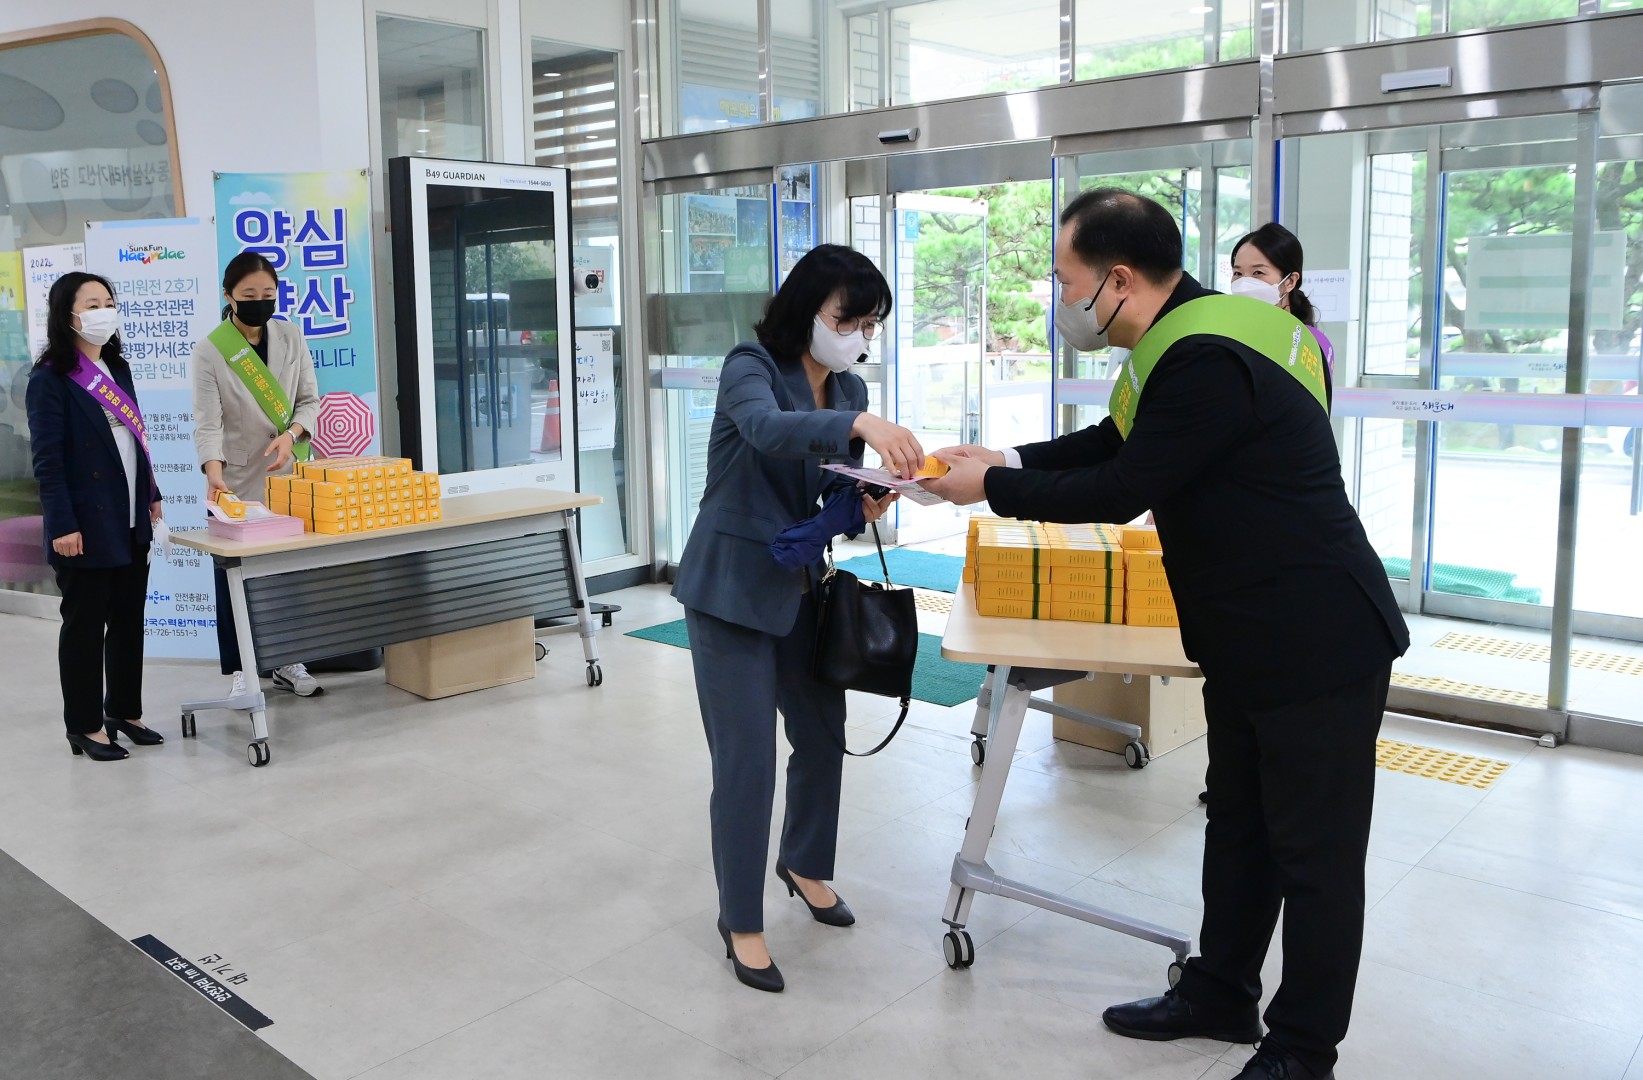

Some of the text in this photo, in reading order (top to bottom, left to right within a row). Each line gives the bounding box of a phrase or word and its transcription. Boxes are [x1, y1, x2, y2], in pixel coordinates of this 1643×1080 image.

[425, 169, 486, 181] B49 GUARDIAN
[235, 207, 346, 269] 양심
[119, 246, 186, 265] Haeundae
[129, 244, 163, 253] Sun&Fun
[112, 277, 199, 297] 고리원전 2호기
[117, 299, 195, 317] 계속운전관련
[124, 320, 189, 339] 방사선환경
[121, 341, 196, 360] 향평가서(초
[132, 362, 186, 380] 공람 안내
